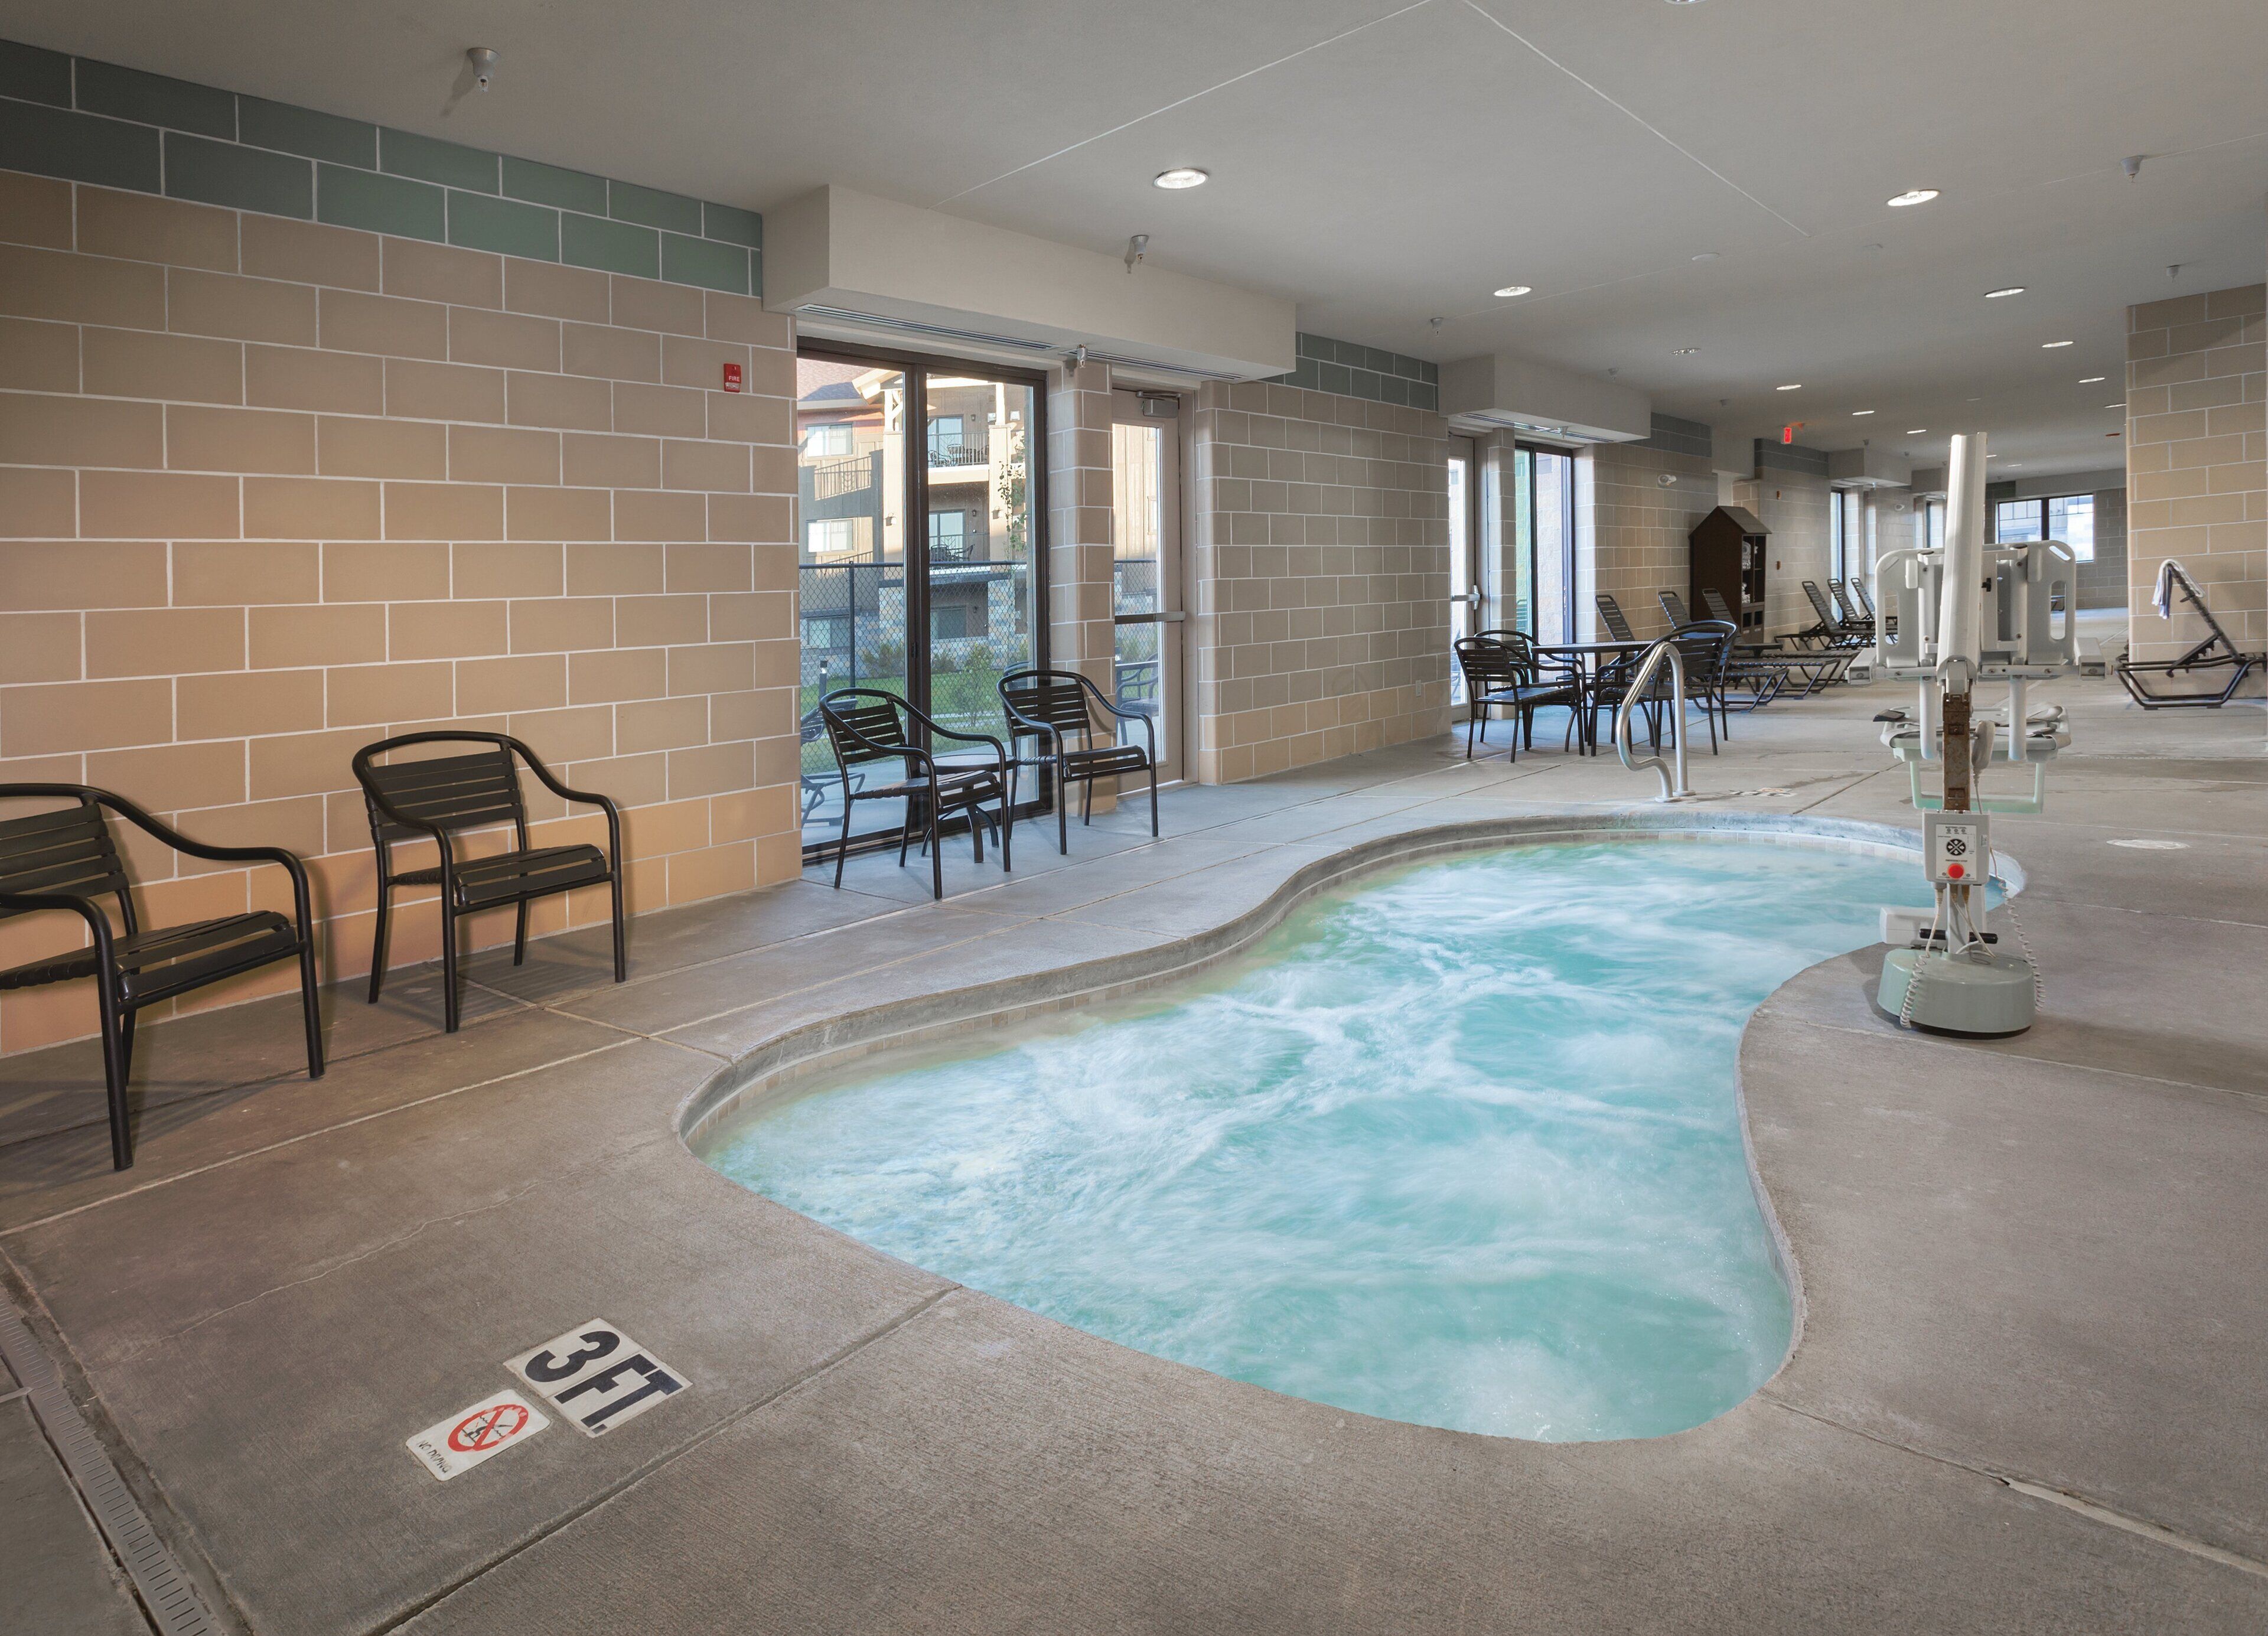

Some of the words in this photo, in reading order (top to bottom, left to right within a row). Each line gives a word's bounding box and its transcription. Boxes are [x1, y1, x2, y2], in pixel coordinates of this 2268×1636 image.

[524, 1331, 620, 1383] 3
[417, 1441, 432, 1451] NO
[426, 1449, 453, 1474] DIVING
